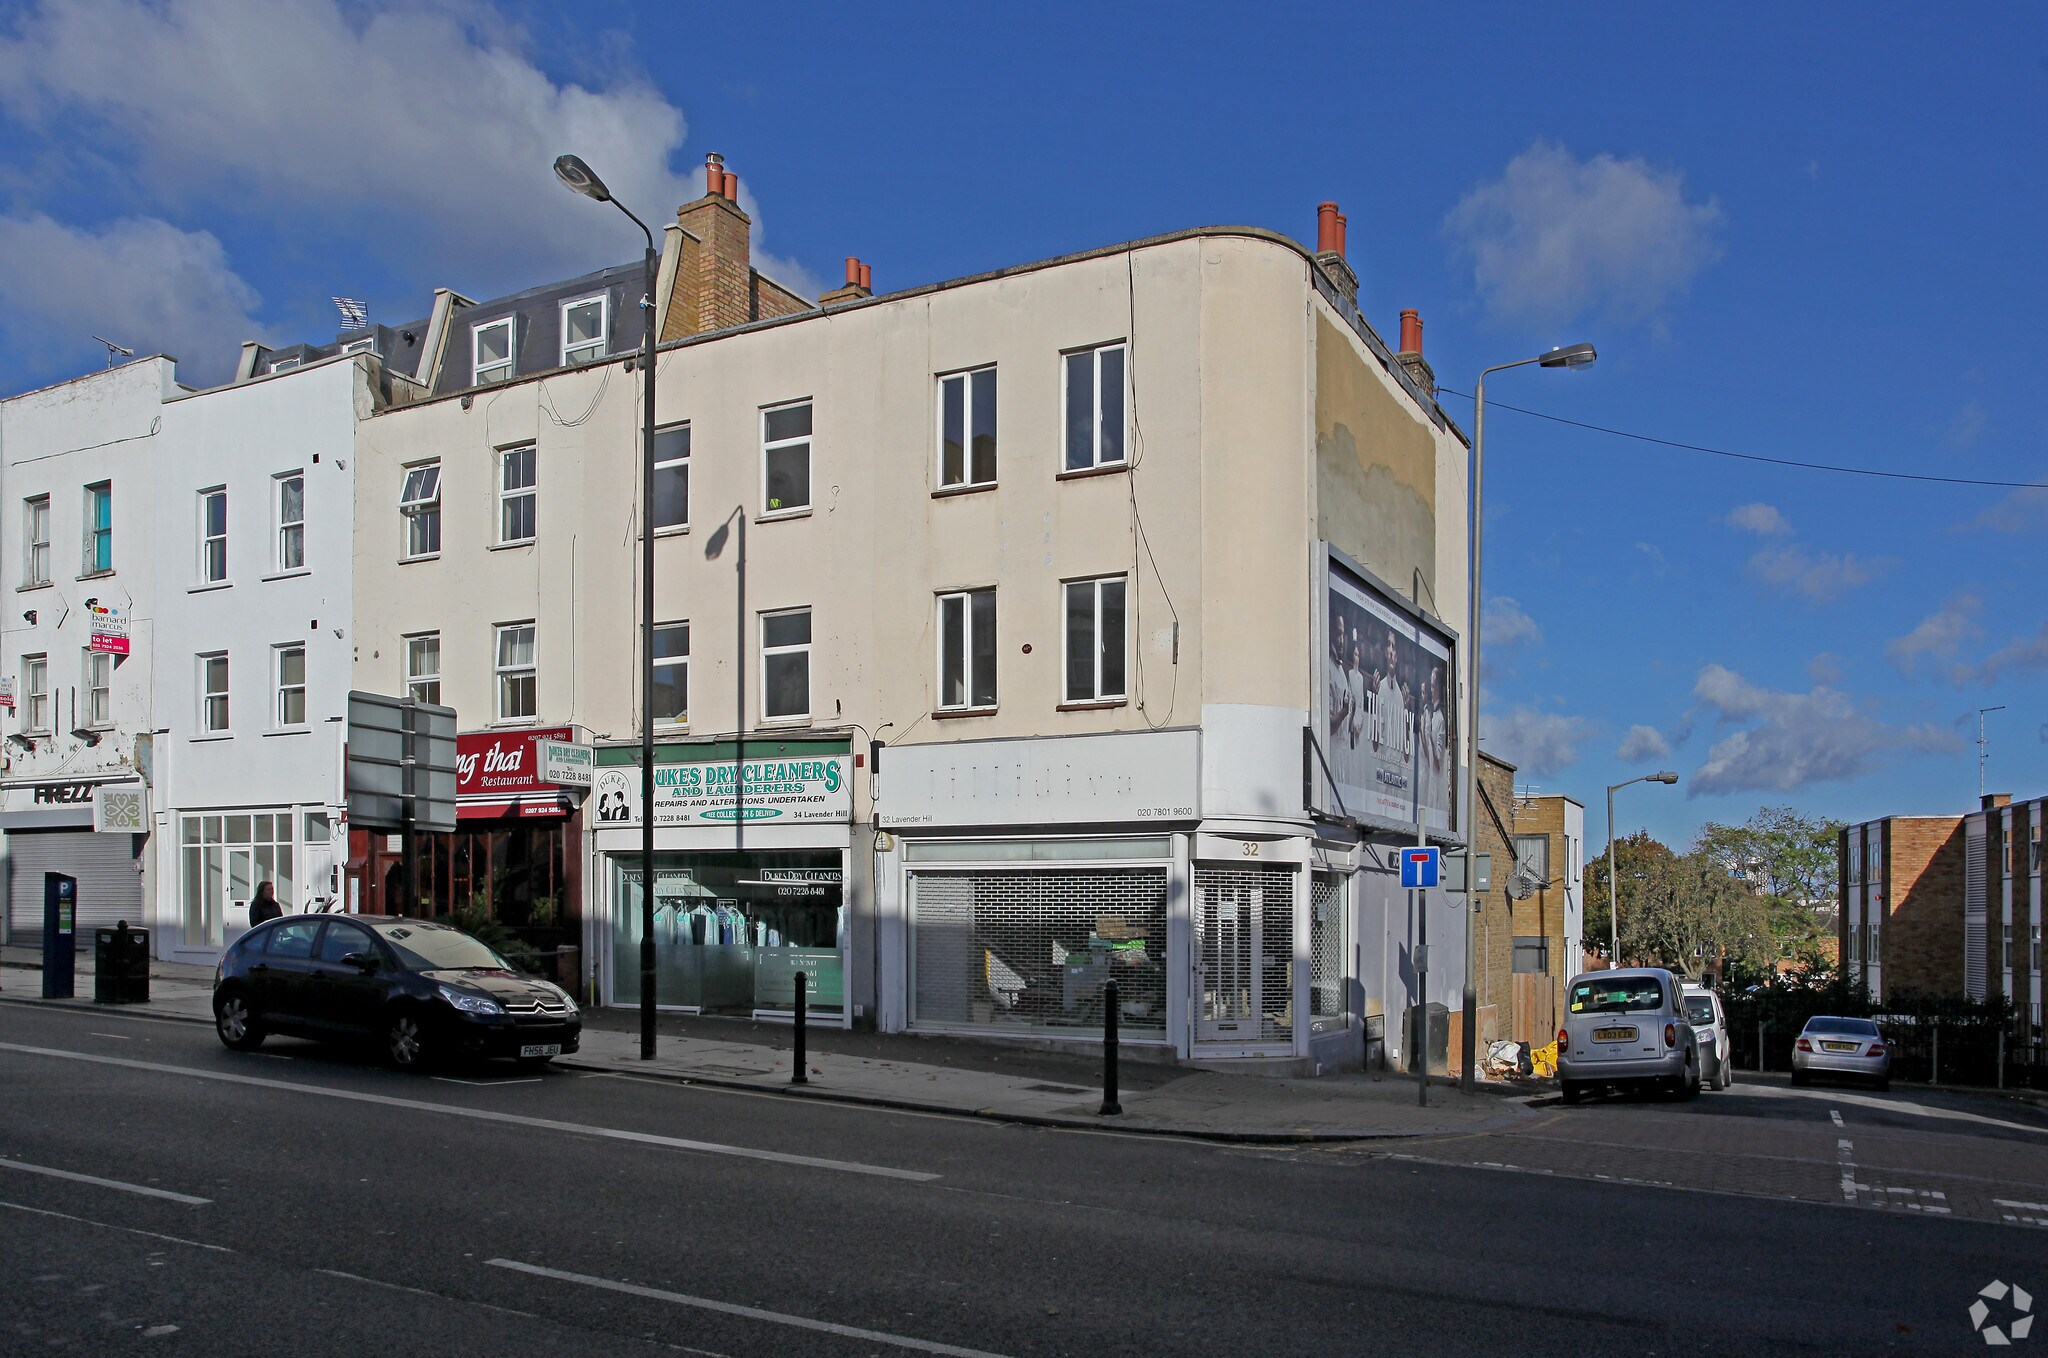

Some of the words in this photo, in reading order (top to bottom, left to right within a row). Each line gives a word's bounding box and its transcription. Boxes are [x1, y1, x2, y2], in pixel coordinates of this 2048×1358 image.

[92, 613, 127, 624] barnard
[92, 621, 123, 631] marcus
[1366, 689, 1385, 745] THE
[483, 740, 525, 773] thai
[480, 774, 534, 787] Restaurant
[549, 769, 561, 779] 020
[561, 771, 577, 781] 7228
[577, 772, 591, 782] 8481
[705, 765, 738, 786] DRY
[742, 760, 841, 793] CLEANERS
[599, 774, 627, 791] DUKES
[672, 786, 703, 798] AND
[706, 783, 805, 797] LAUNDERERS
[654, 800, 688, 808] REPAIRS
[690, 799, 707, 807] AND
[709, 797, 765, 806] ALTERATIONS
[767, 795, 826, 804] UNDERTAKEN
[804, 810, 833, 818] Lavender
[835, 809, 848, 817] Hill
[1137, 808, 1152, 817] 020
[1153, 807, 1171, 816] 7801
[1173, 807, 1193, 816] 9600
[675, 814, 690, 822] 8481
[882, 815, 890, 824] 32
[891, 815, 921, 823] Lavender
[922, 814, 933, 822] Hill
[1242, 842, 1259, 857] 32
[764, 870, 786, 881] DUKES
[788, 870, 804, 881] DRY
[804, 870, 842, 881] CLEANERS
[60, 882, 69, 894] P
[777, 887, 792, 896] 020
[793, 887, 809, 896] 7228
[810, 887, 825, 896] 8481
[1597, 1031, 1617, 1040] LX03
[523, 1046, 544, 1056] FH56
[544, 1045, 559, 1055] JEU
